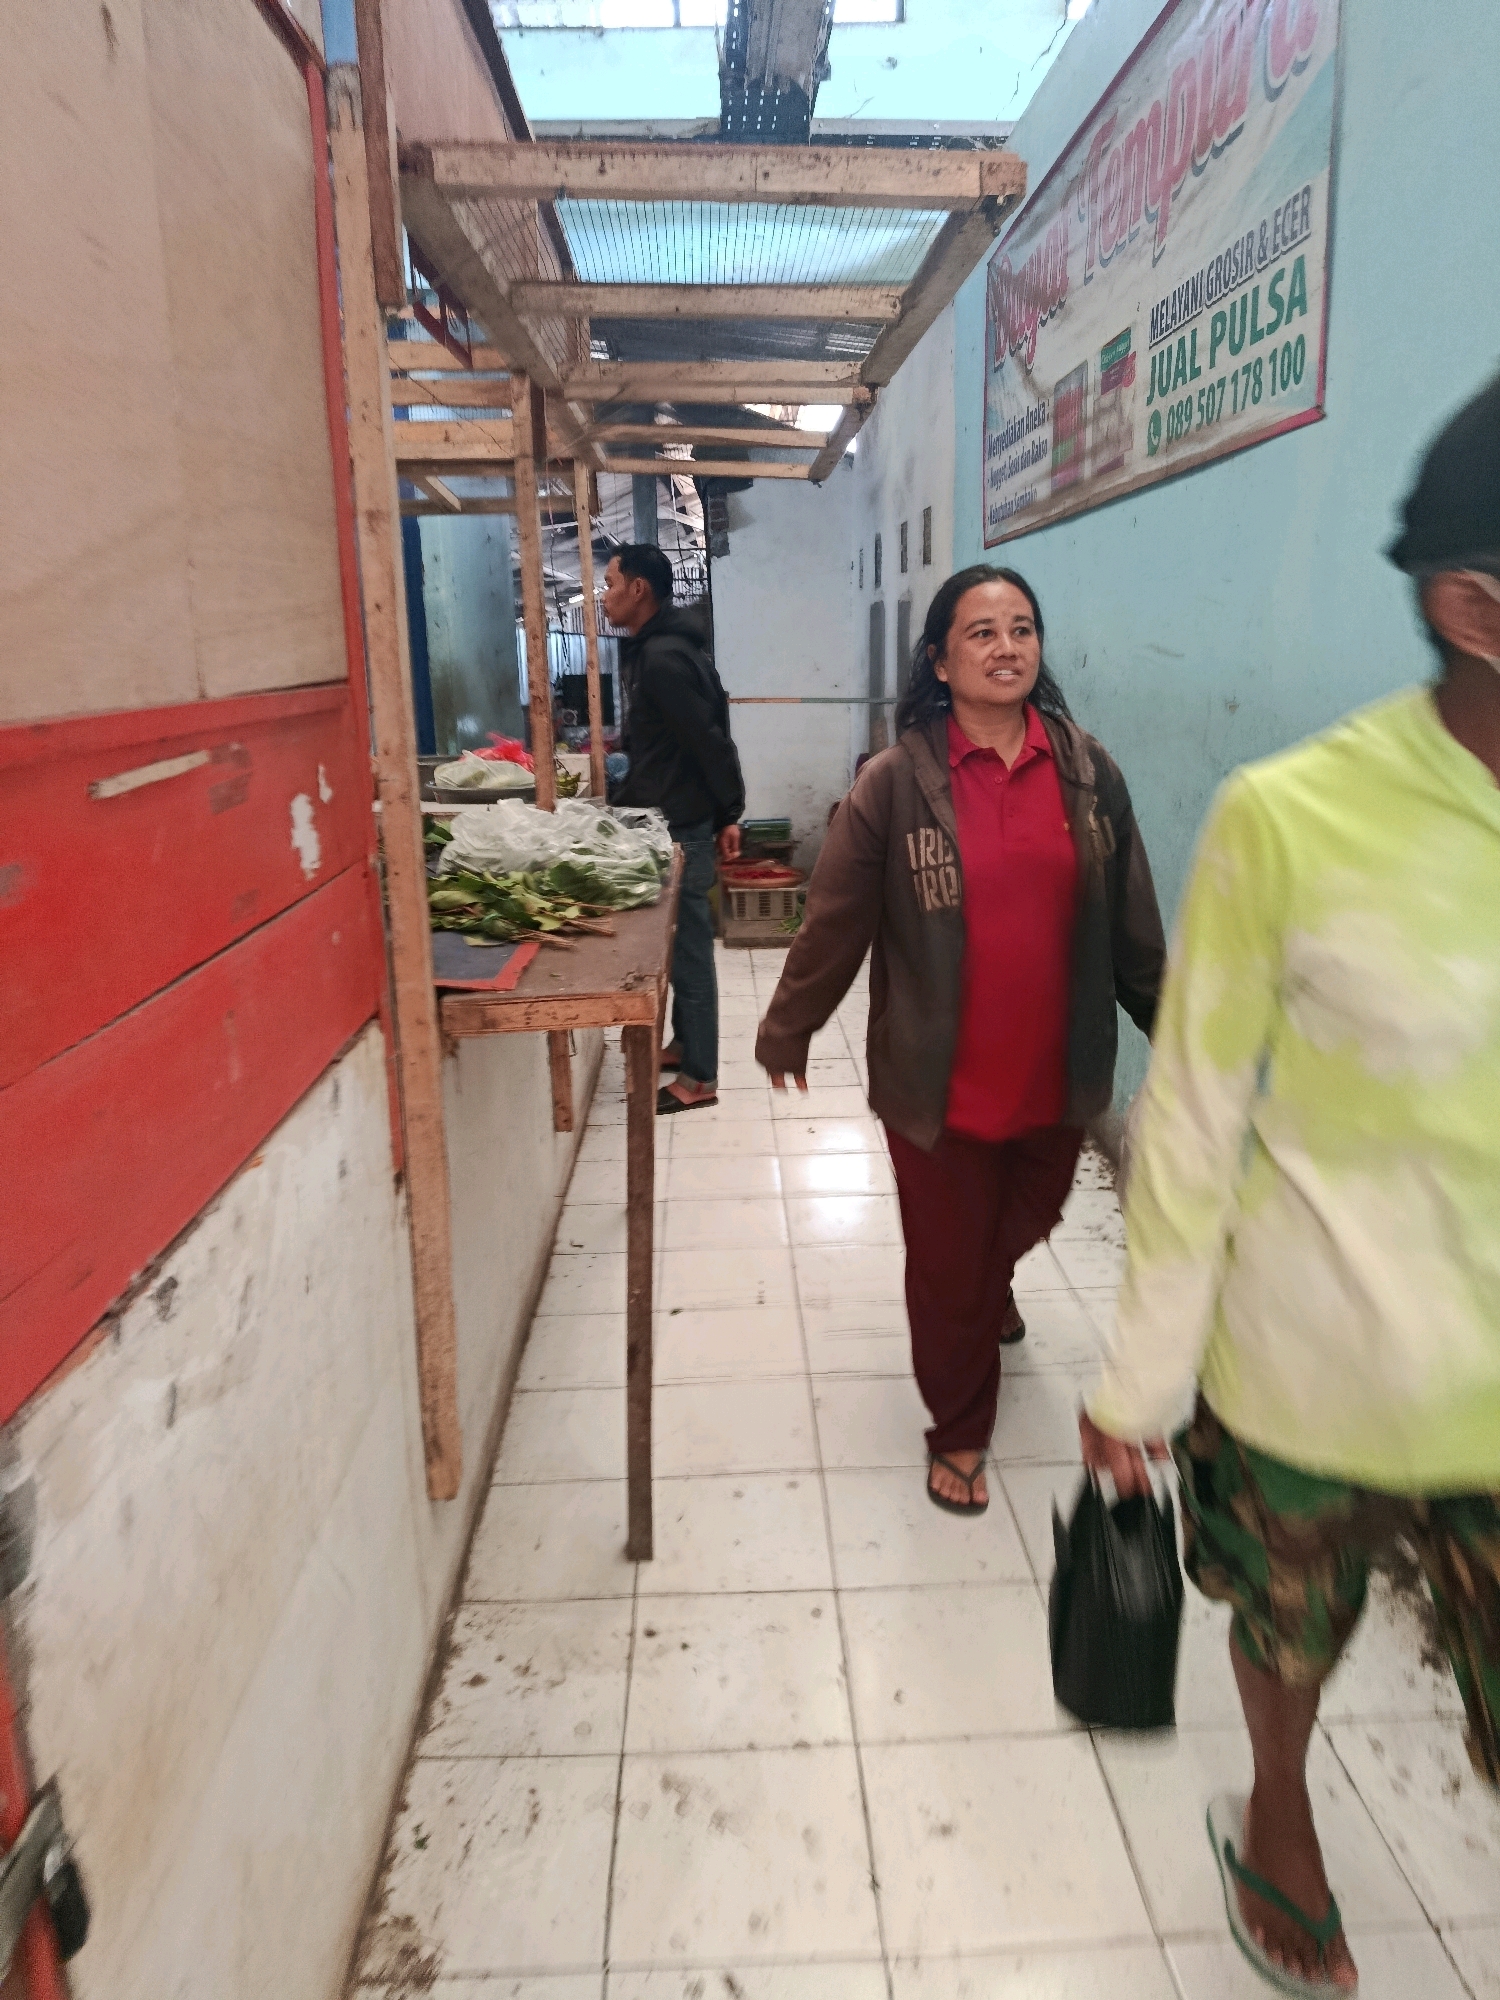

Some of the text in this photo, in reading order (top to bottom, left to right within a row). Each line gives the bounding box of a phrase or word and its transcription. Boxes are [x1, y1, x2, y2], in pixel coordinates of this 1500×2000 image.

[1146, 254, 1307, 406] JUAL PULSA
[1149, 184, 1311, 346] MELAYANI GROSIR & ECER
[988, 415, 1025, 461] Menyediakan
[1025, 397, 1046, 436] Aneka
[1167, 333, 1305, 445] 089 507 178 100
